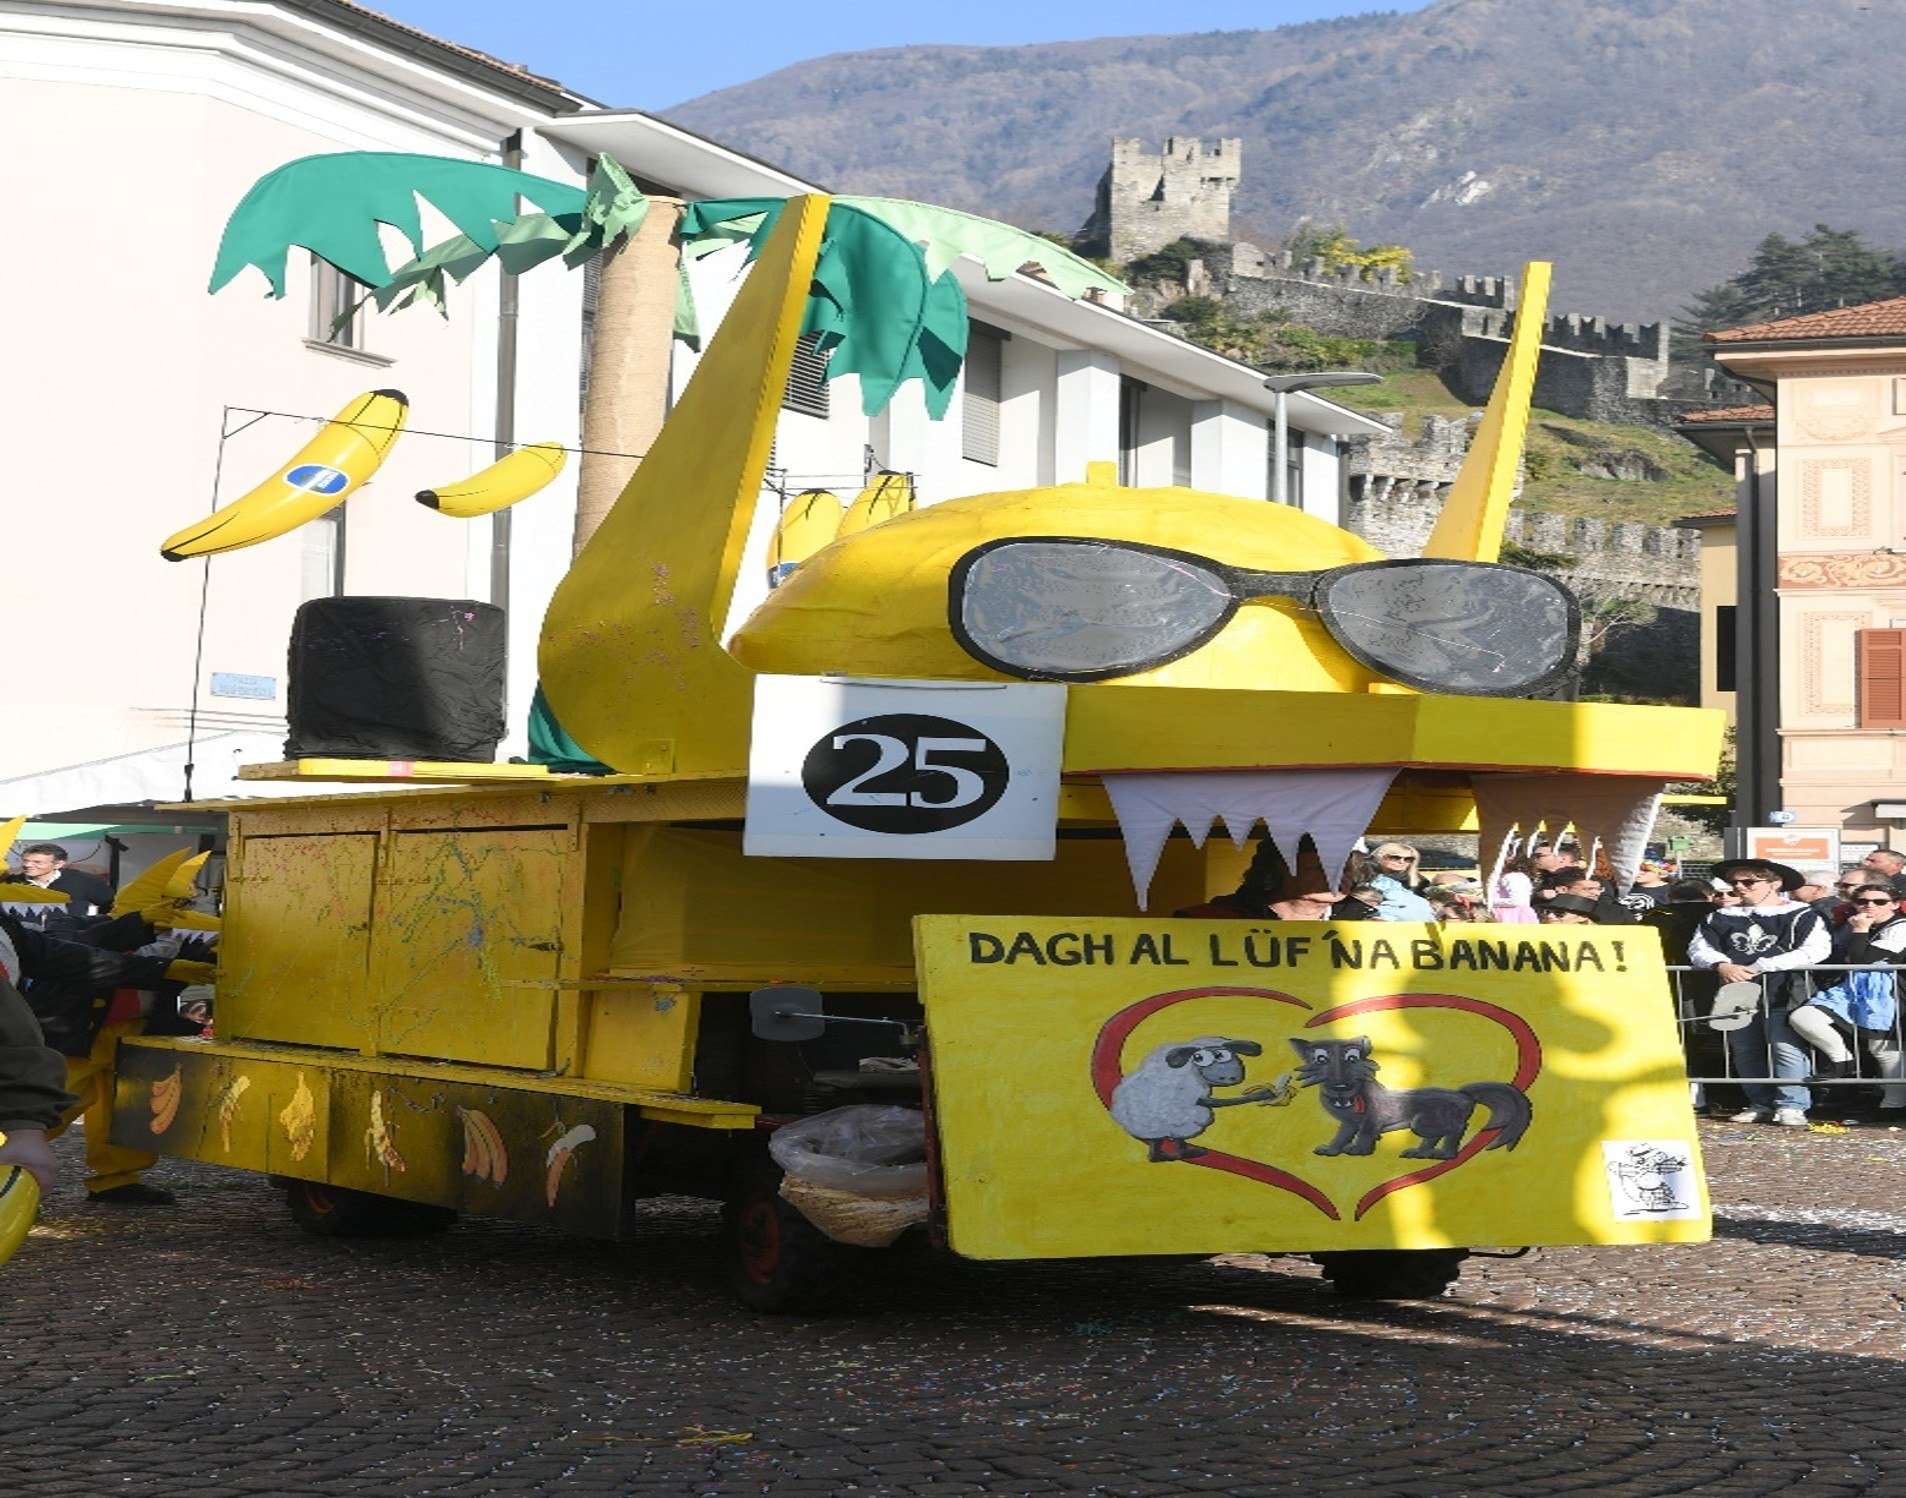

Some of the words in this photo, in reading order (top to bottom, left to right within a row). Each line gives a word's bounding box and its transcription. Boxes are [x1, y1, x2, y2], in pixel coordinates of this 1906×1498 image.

[826, 733, 988, 809] 25
[968, 931, 1115, 966] DAGH
[1129, 933, 1190, 965] AL
[1209, 928, 1312, 968] LÜF
